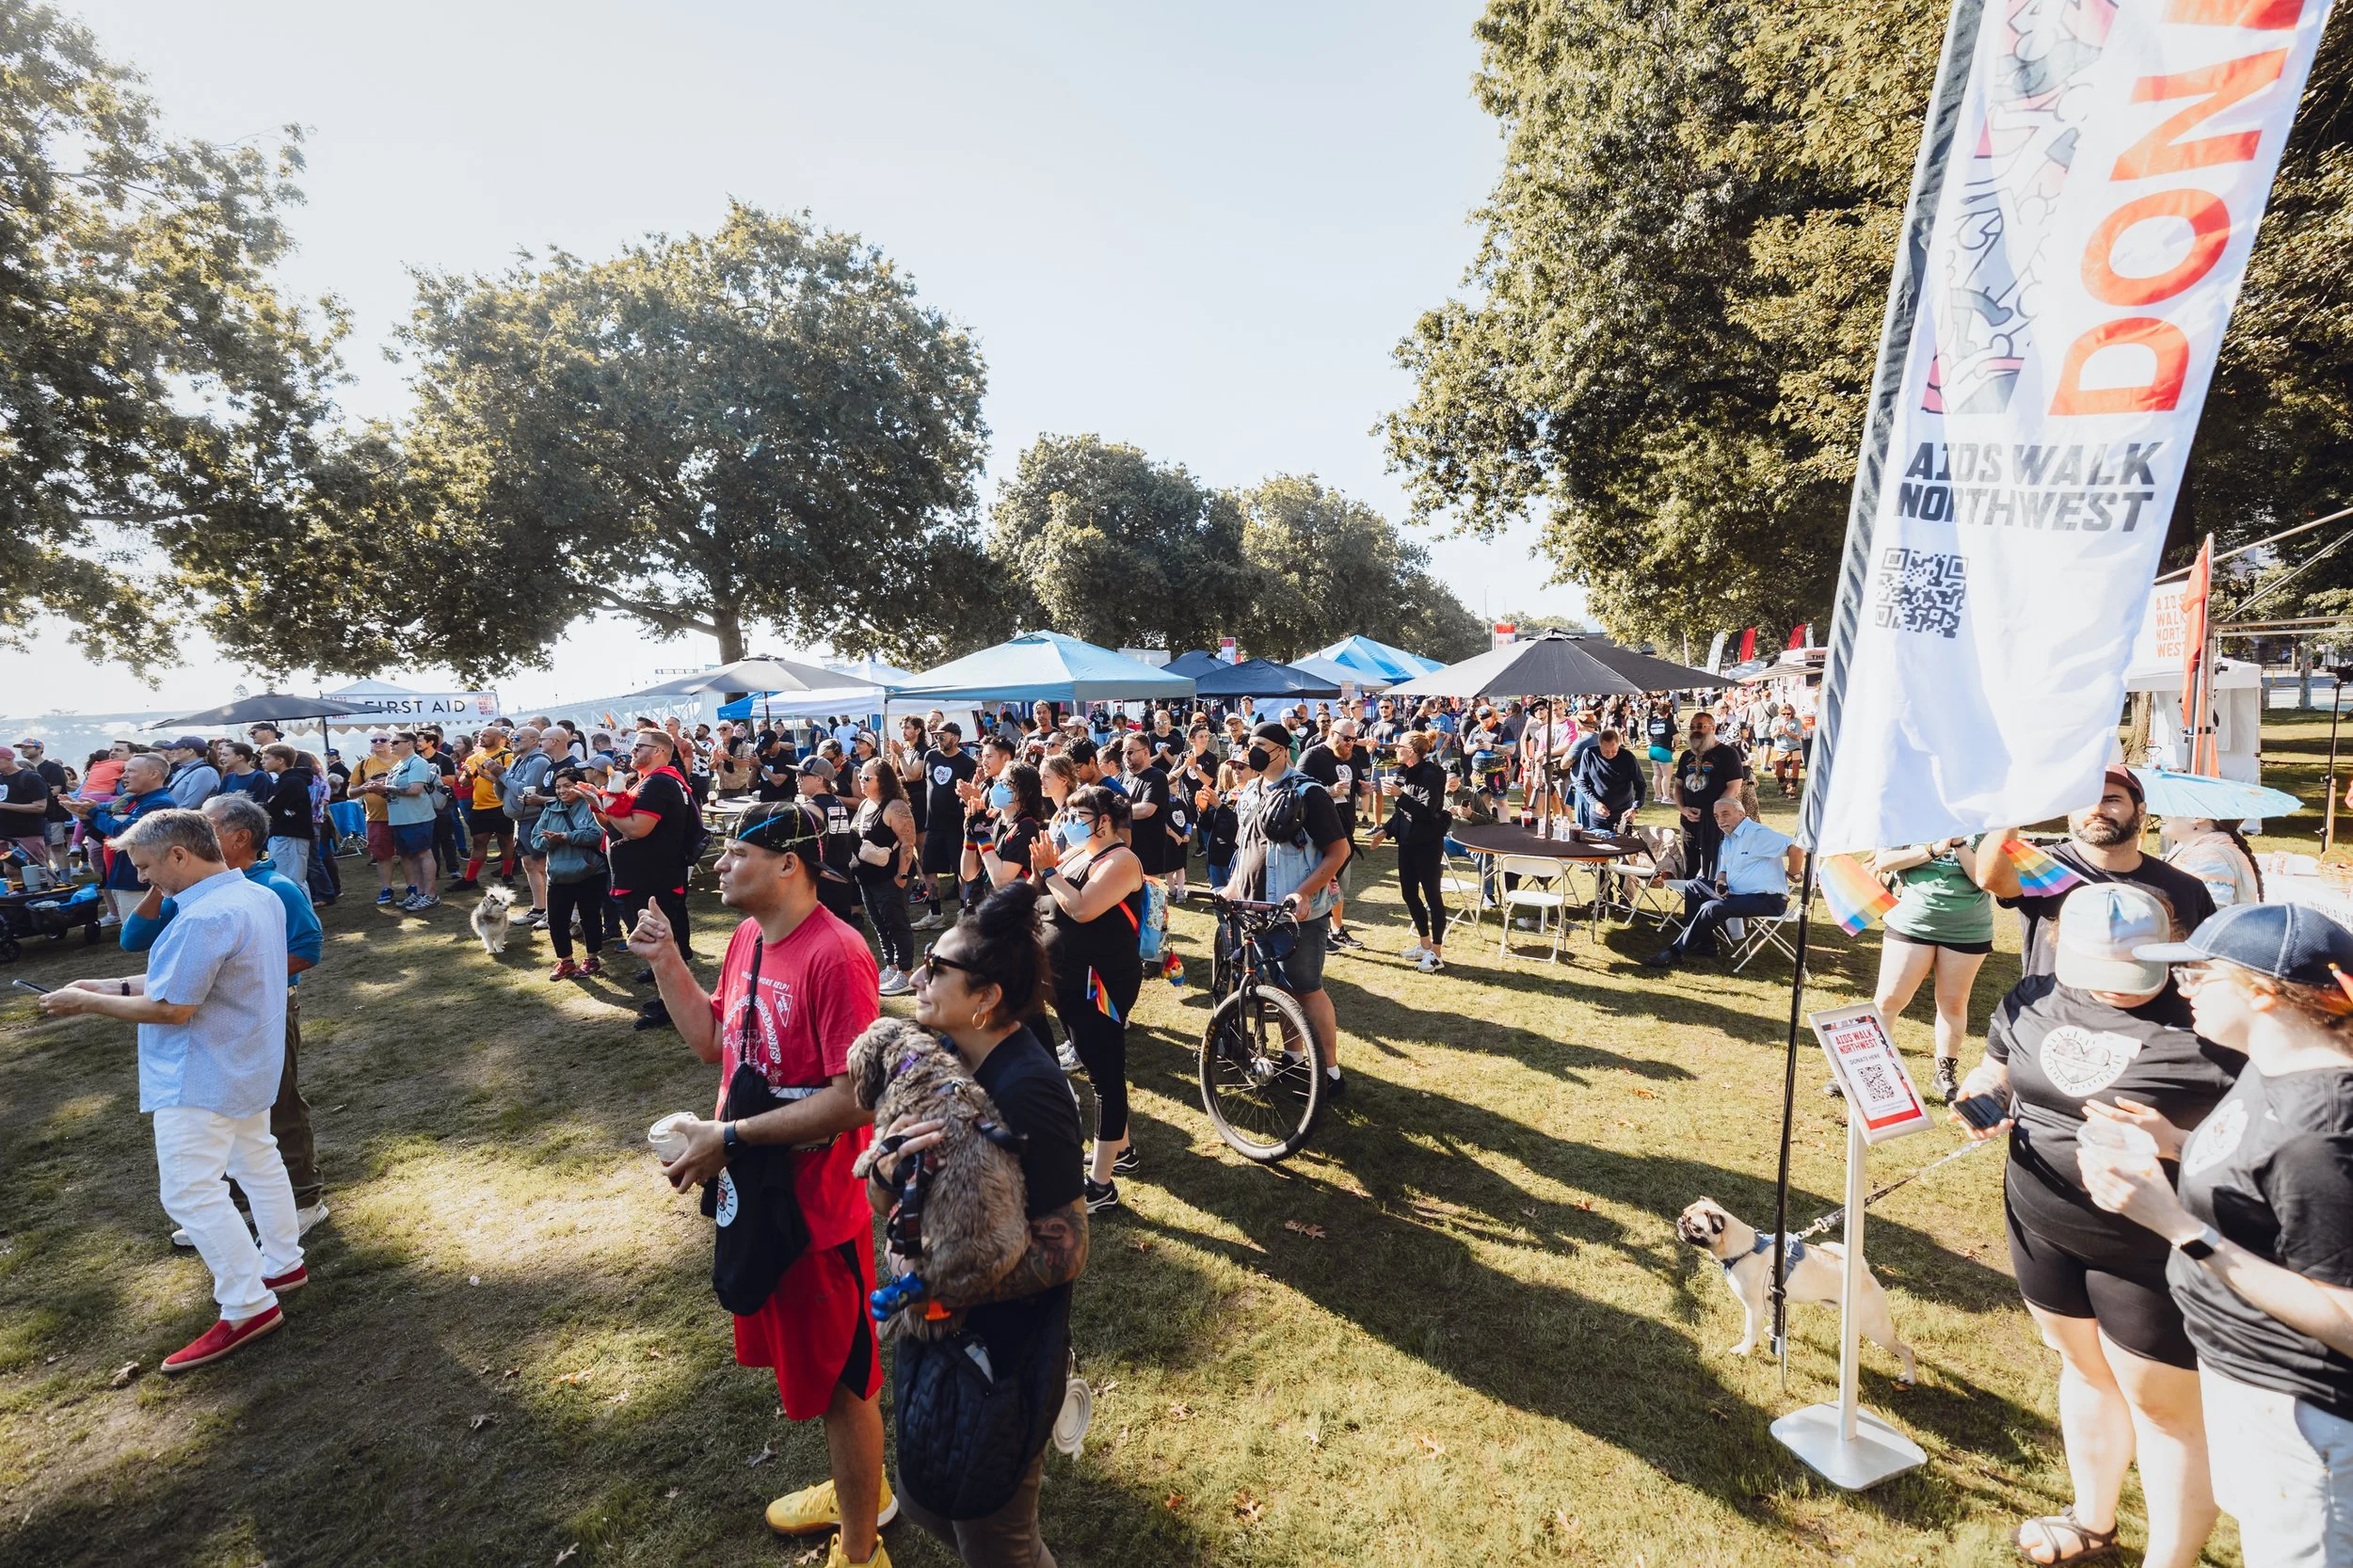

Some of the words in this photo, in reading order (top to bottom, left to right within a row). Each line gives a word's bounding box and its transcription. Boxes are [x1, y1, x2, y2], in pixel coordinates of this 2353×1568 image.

[2048, 0, 2306, 416] DON
[1905, 441, 2003, 483] AIDS
[2012, 441, 2166, 486] WALK
[1894, 481, 2155, 533] NORTHWEST
[2155, 642, 2185, 658] WES
[432, 699, 466, 713] AID
[1835, 1033, 1853, 1045] AIDS
[1854, 1029, 1874, 1041] WALK
[1838, 1038, 1878, 1054] NORTHWEST
